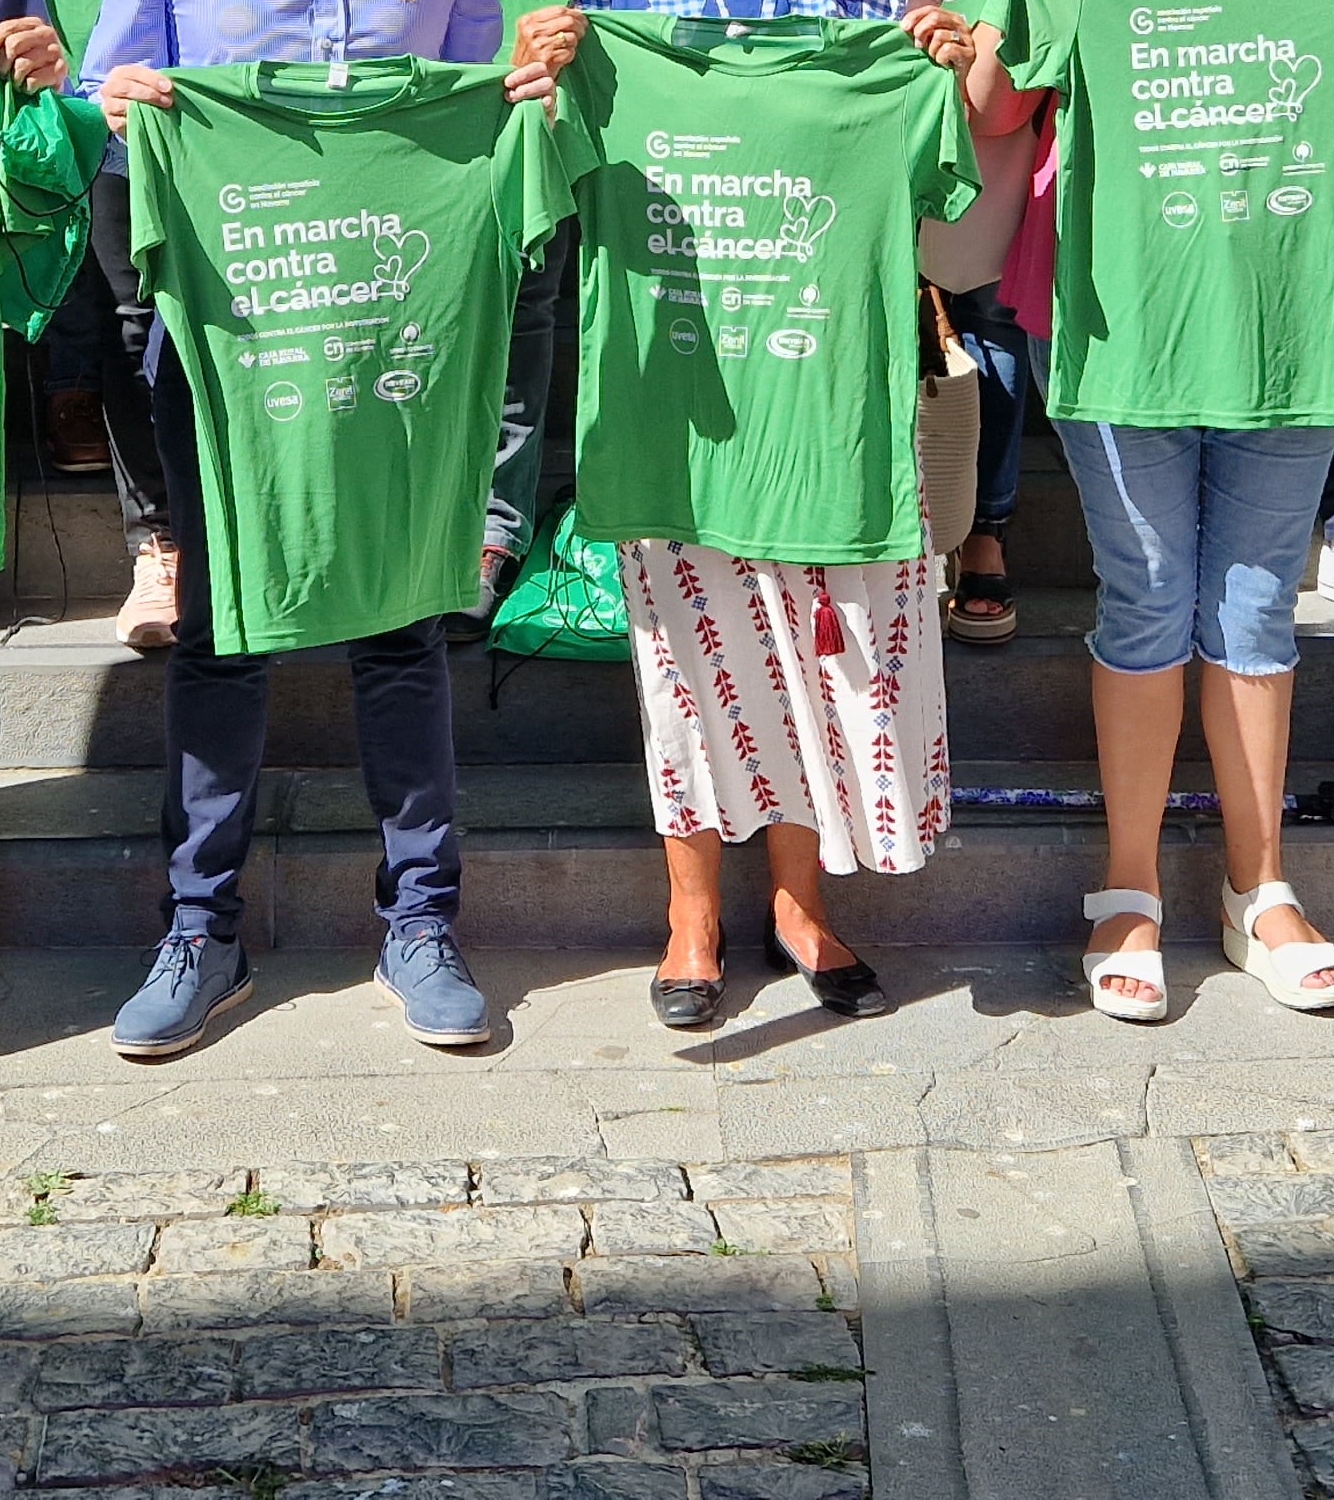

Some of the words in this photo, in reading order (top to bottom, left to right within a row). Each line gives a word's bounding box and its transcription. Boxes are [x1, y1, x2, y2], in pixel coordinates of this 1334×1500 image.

[1131, 42, 1169, 70] En
[1177, 33, 1296, 67] marcha
[1131, 70, 1235, 100] contra
[1133, 102, 1161, 131] el
[1170, 100, 1275, 129] cáncer
[645, 165, 683, 194] En
[691, 169, 812, 197] marcha
[646, 199, 745, 228] contra
[222, 222, 265, 252] En
[273, 208, 402, 246] marcha
[647, 228, 673, 254] el
[681, 230, 787, 260] cáncer
[226, 249, 338, 284] contra
[230, 285, 262, 318] el
[270, 280, 382, 313] cáncer
